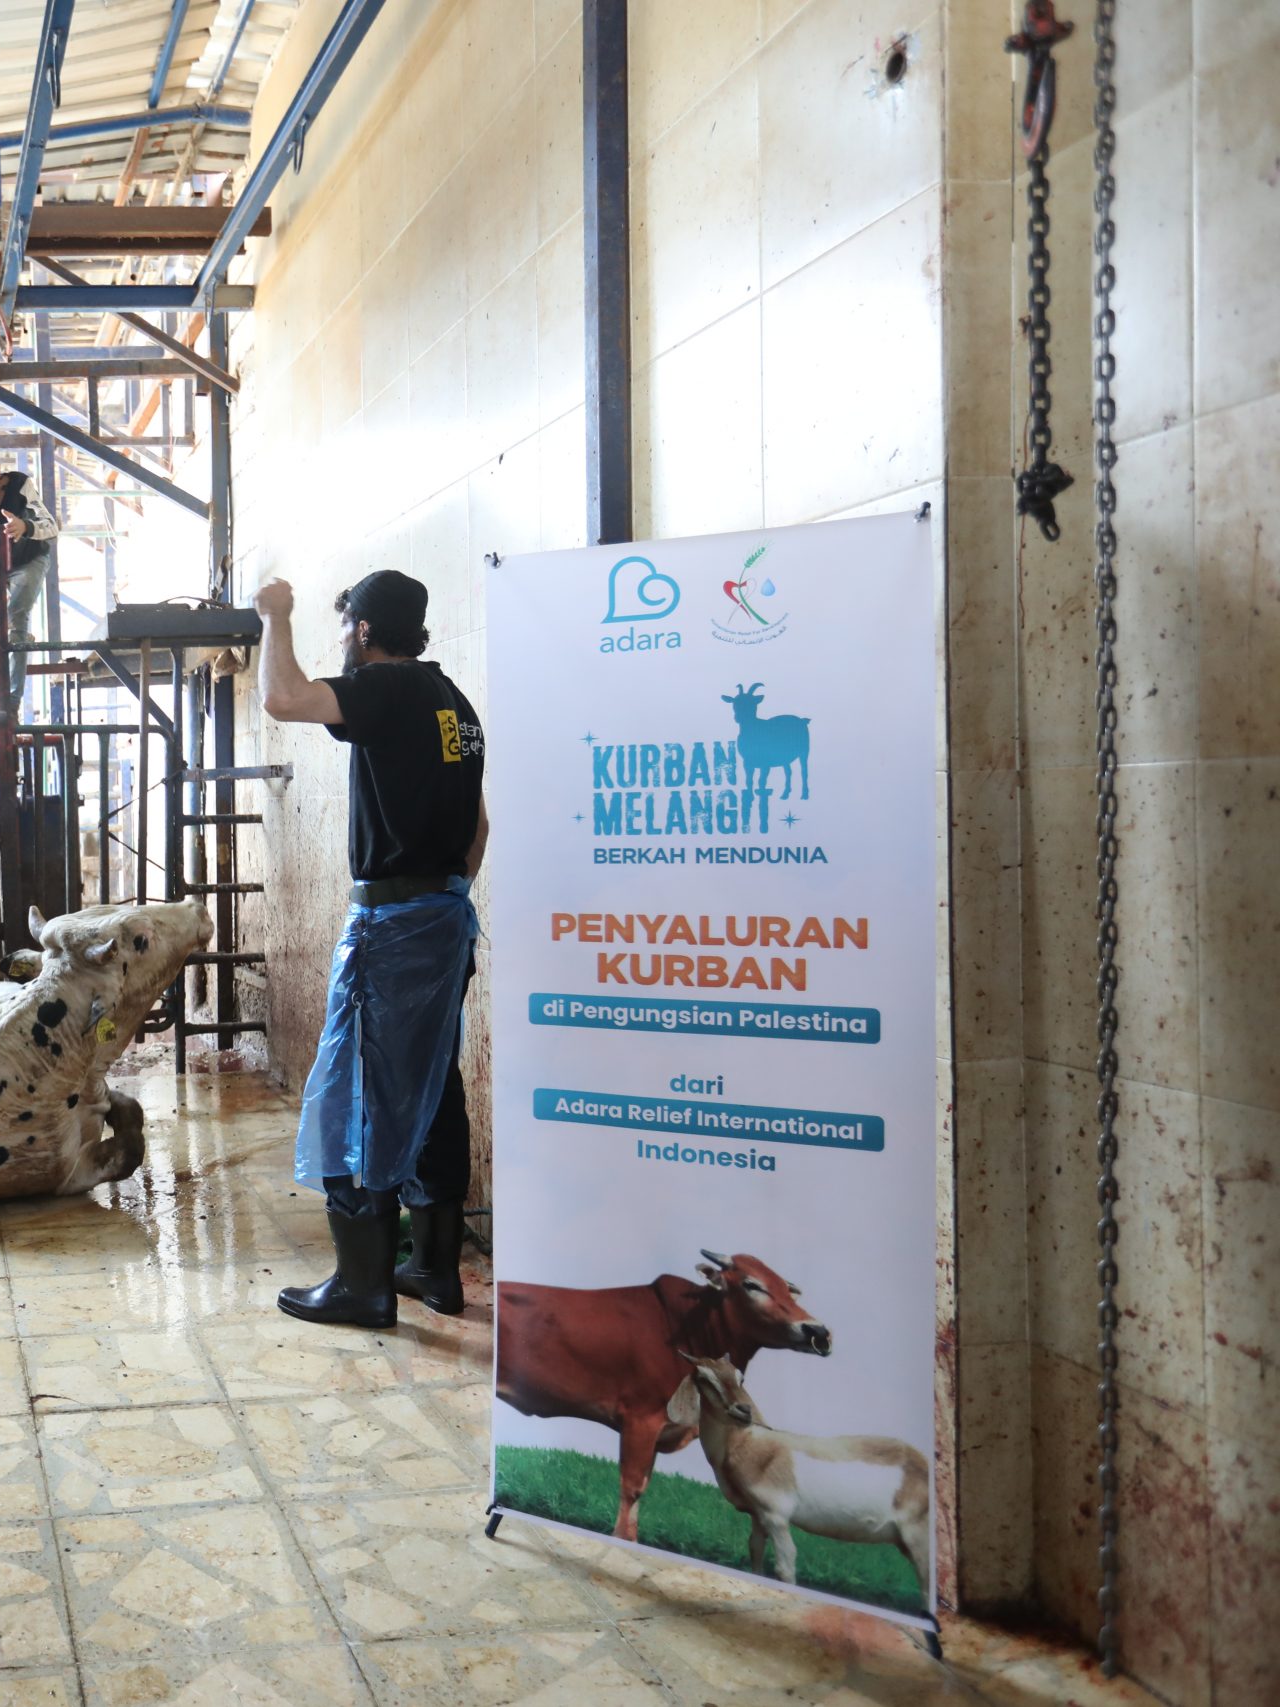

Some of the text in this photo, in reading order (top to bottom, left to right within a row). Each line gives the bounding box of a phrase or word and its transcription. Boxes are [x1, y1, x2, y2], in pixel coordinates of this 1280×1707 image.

[599, 626, 682, 654] adara
[593, 741, 737, 789] KURBAN
[593, 789, 773, 836] MELANGIT
[593, 846, 829, 865] BERKAH MENDUNIA
[551, 913, 869, 949] PENYALURAN
[597, 952, 807, 992] KURBAN
[542, 998, 868, 1035] di Pengungsian Palestina
[669, 1075, 724, 1096] dari
[554, 1097, 863, 1142] Adara Relief International
[636, 1139, 776, 1172] Indonesia
